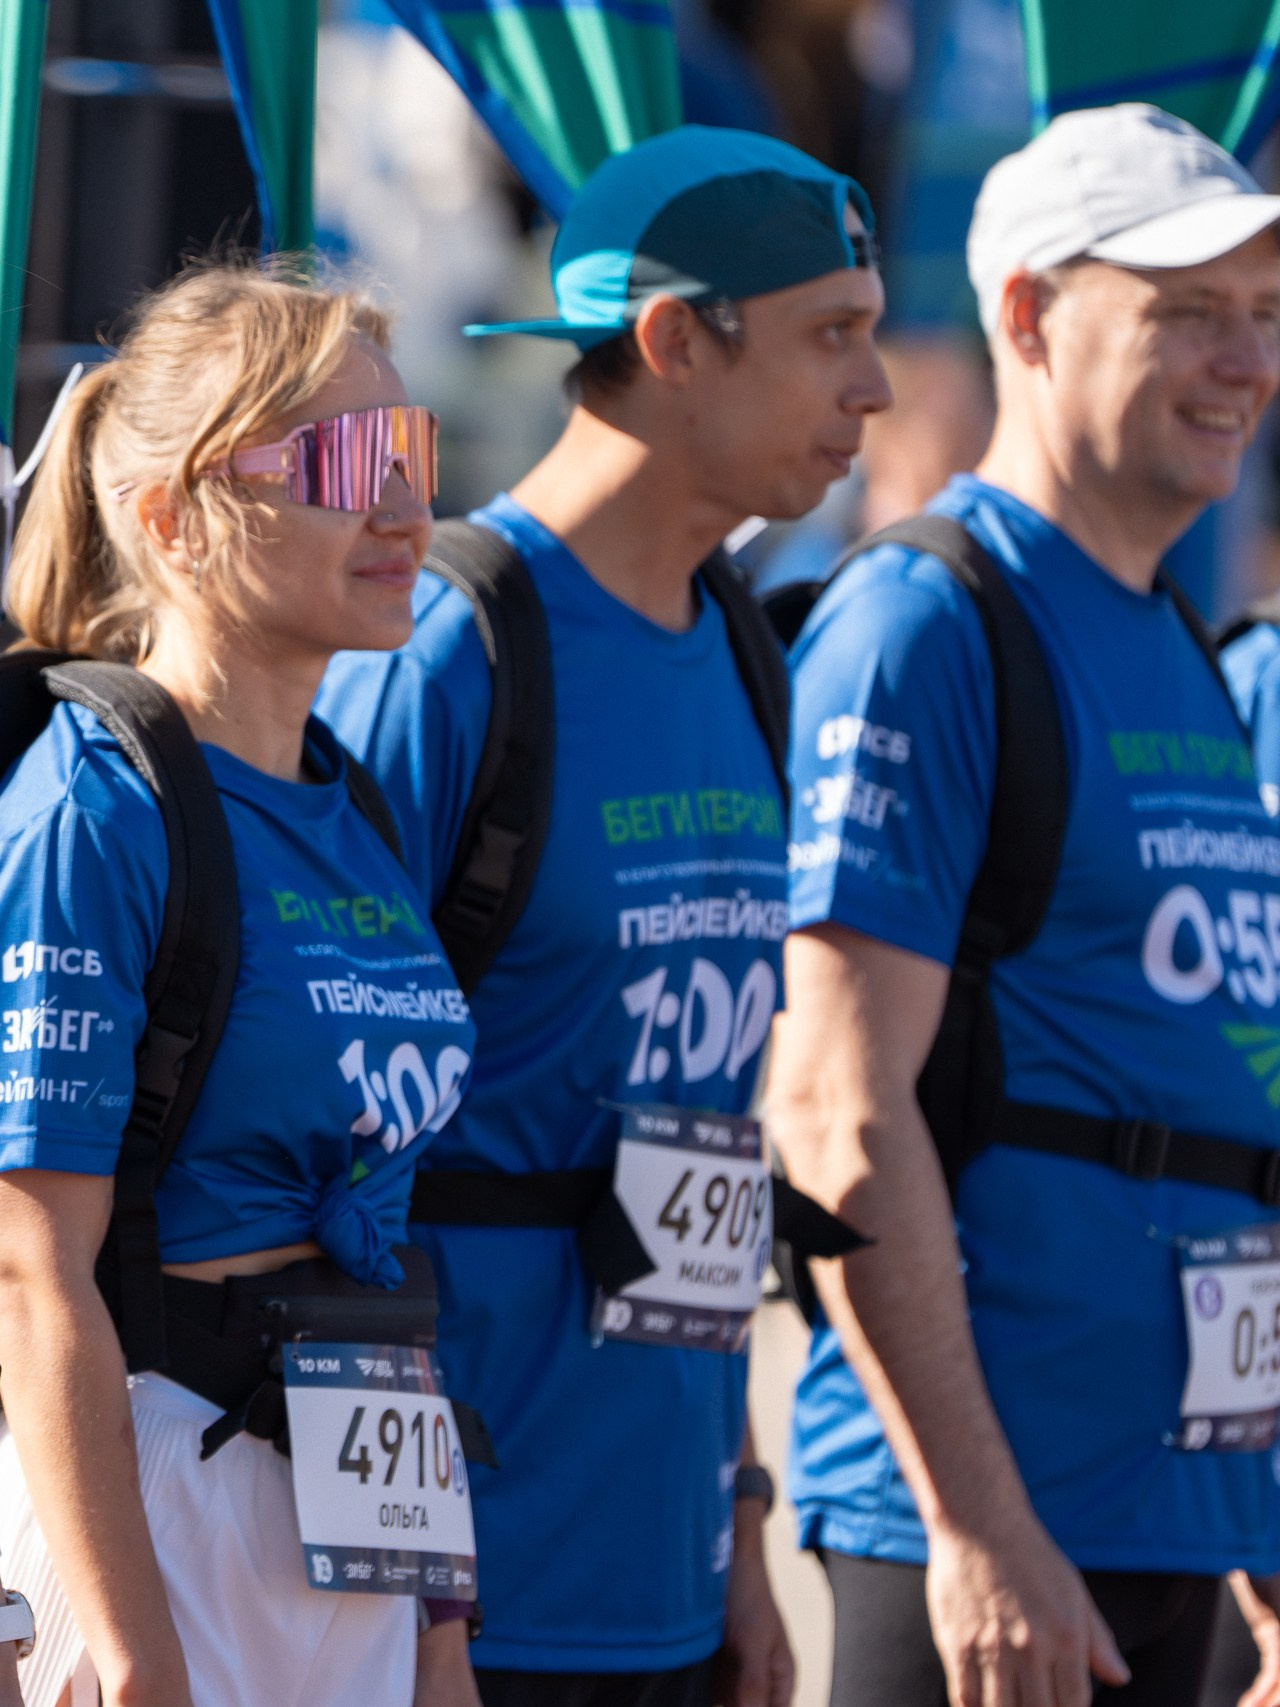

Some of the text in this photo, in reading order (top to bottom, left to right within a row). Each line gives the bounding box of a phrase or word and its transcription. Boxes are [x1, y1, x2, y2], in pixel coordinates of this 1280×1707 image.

[35, 944, 103, 977] ПСБ
[621, 957, 777, 1086] 1:00
[657, 1167, 768, 1249] 4909
[337, 1405, 451, 1491] 4910
[379, 1503, 430, 1531] ОЛЬГА
